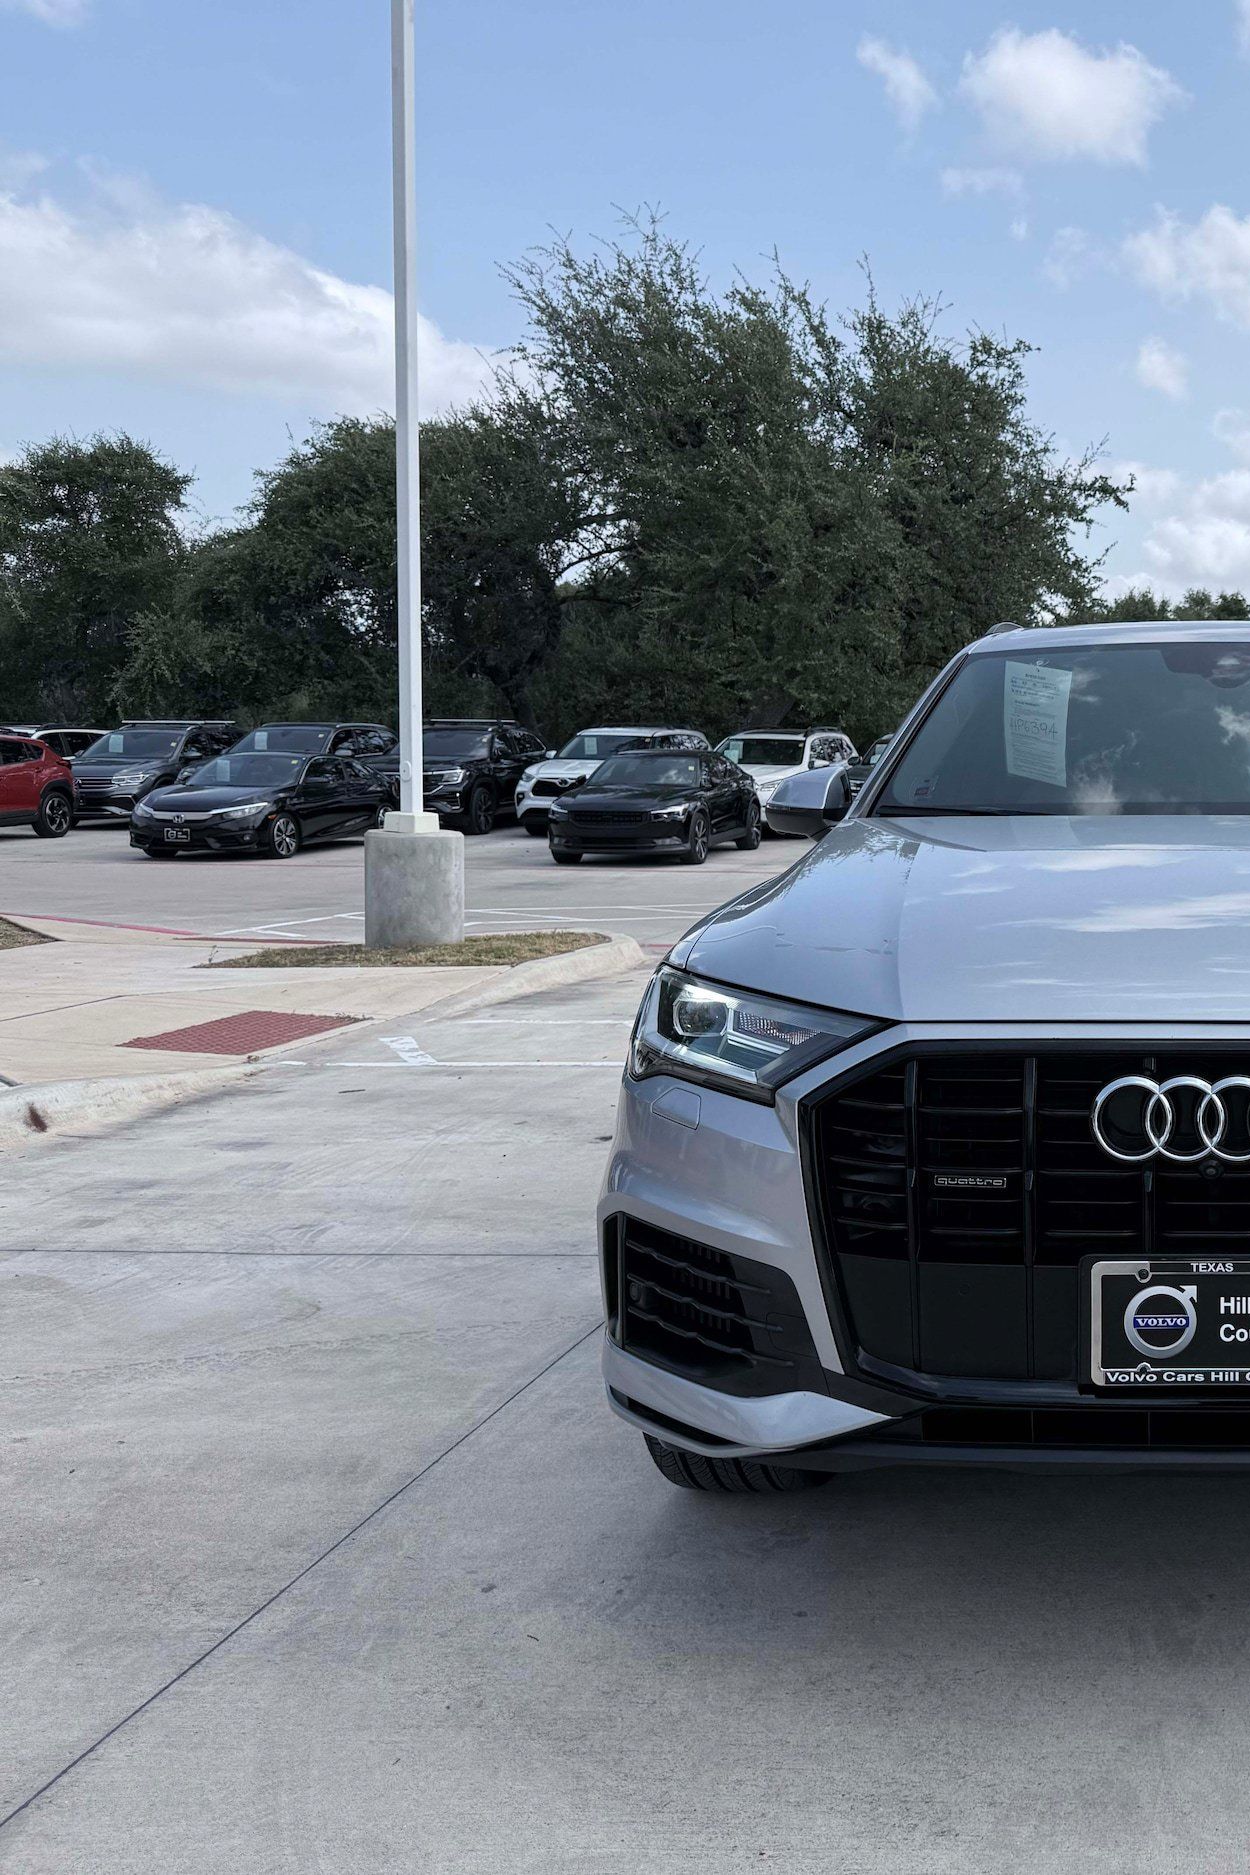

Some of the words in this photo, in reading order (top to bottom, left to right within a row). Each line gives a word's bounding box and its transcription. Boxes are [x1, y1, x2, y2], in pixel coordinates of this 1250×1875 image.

[937, 1177, 1003, 1186] quattro
[1190, 1262, 1234, 1273] TEXAS
[1135, 1317, 1187, 1327] VOLVO
[1106, 1371, 1158, 1383] Volvo
[1162, 1371, 1205, 1382] Cars
[1210, 1371, 1240, 1382] Hill
